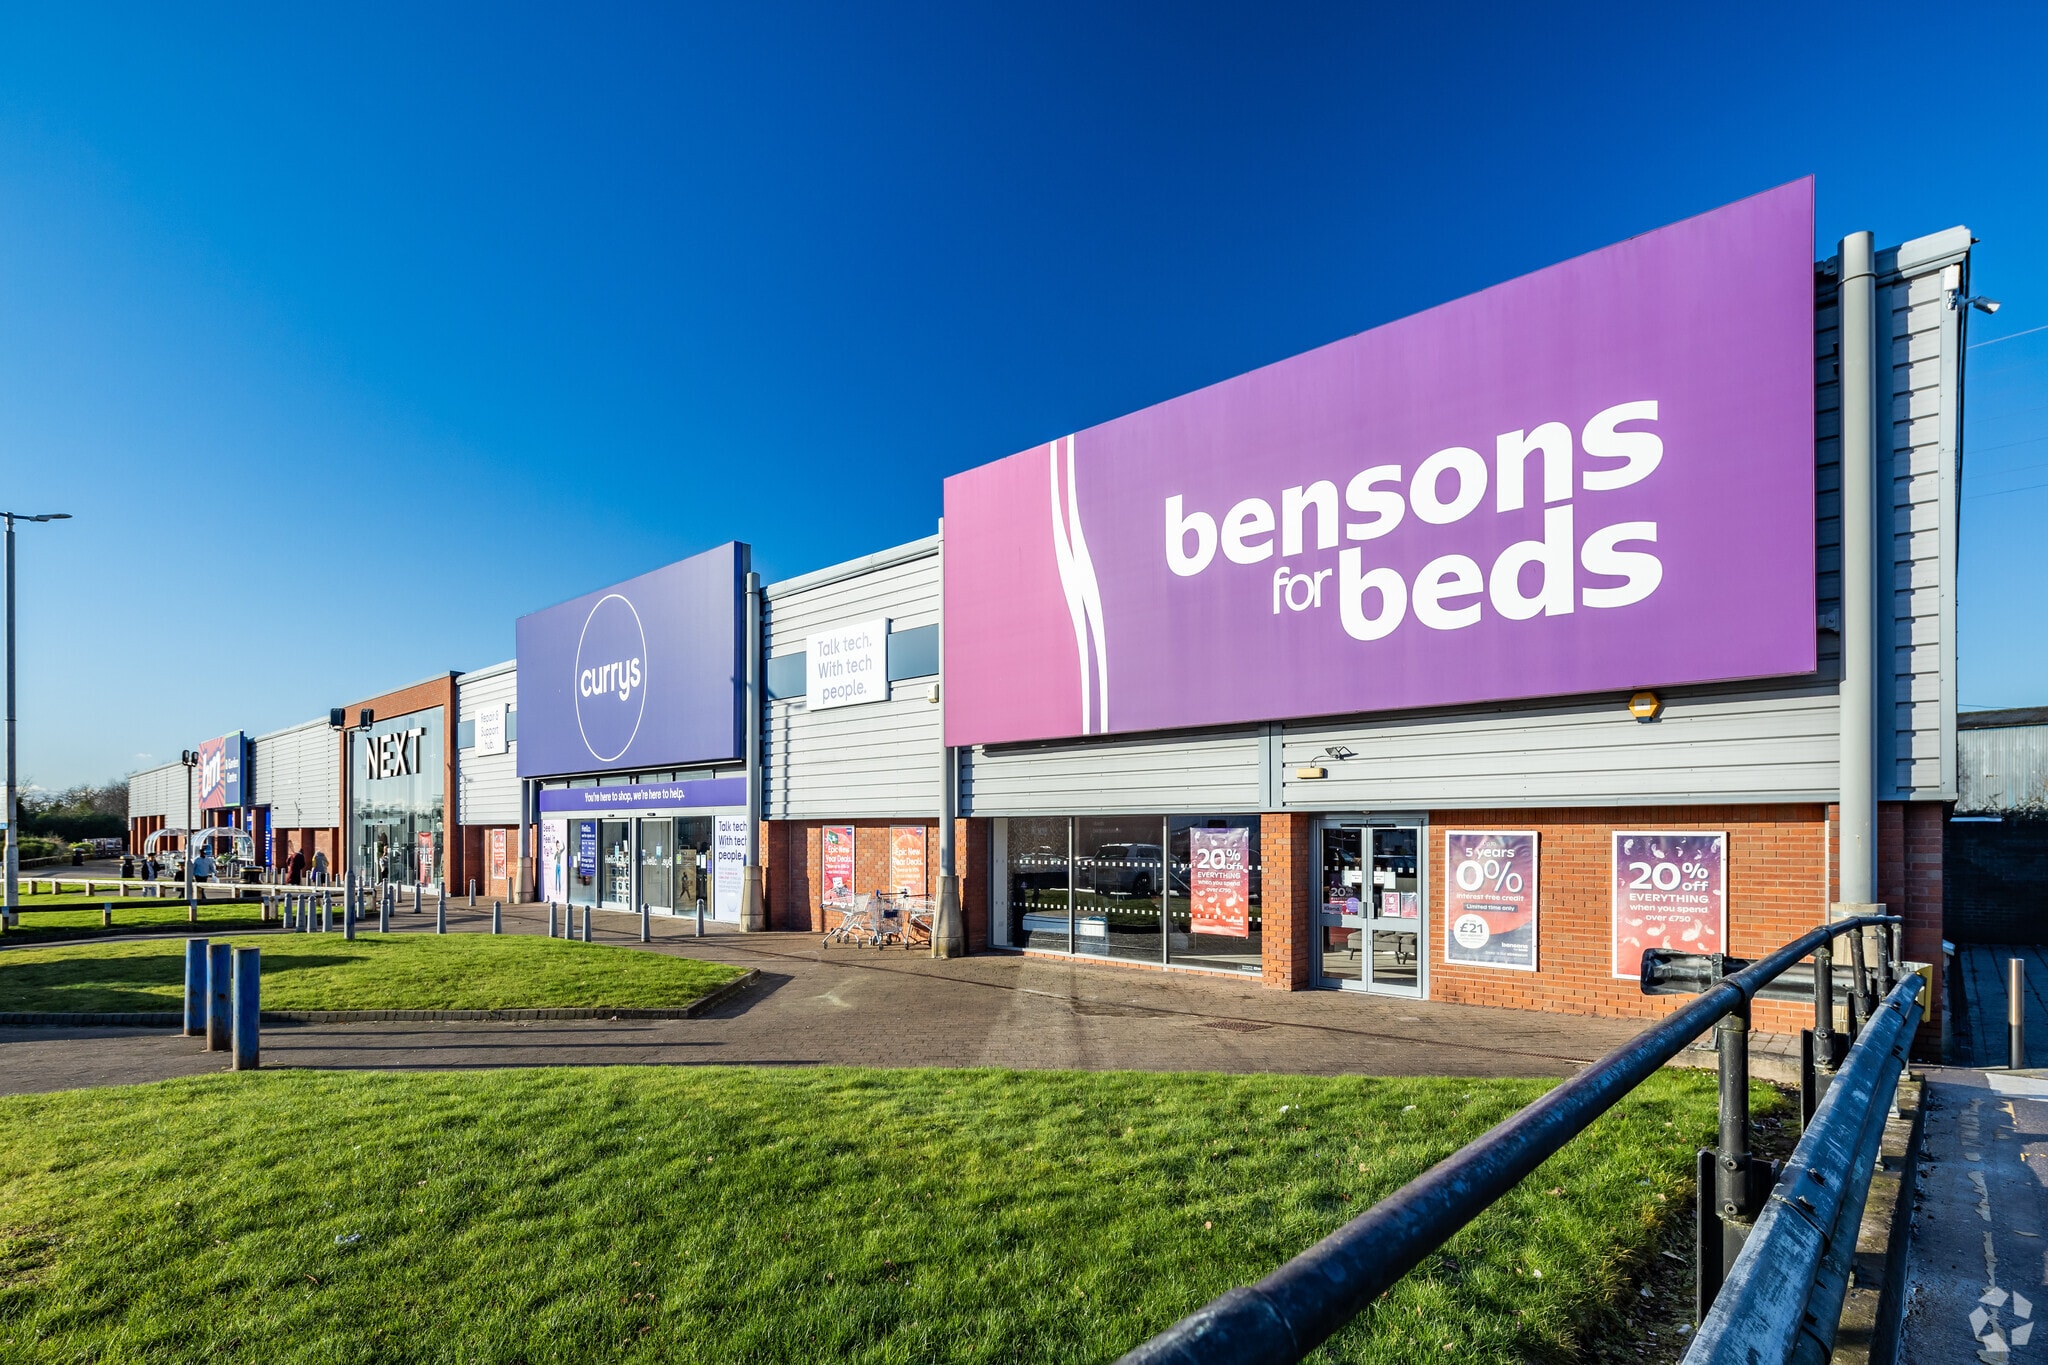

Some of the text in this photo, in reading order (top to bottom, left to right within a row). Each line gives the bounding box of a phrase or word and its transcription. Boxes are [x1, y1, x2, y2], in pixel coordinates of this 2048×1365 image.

[1165, 400, 1664, 577] bensons
[1273, 504, 1664, 641] for beds
[818, 632, 872, 658] Talk tech.
[818, 654, 872, 680] With tech
[580, 657, 642, 702] currys
[822, 680, 867, 704] people.
[481, 726, 499, 738] Support
[366, 727, 426, 780] NEXT
[584, 787, 685, 804] You're here to shop, we're here to help.
[718, 820, 747, 832] Talk tech
[718, 834, 732, 846] With
[718, 849, 743, 863] people.
[828, 845, 850, 855] Epic New
[895, 847, 920, 857] Epic New
[1465, 847, 1515, 859] 5 years
[420, 853, 432, 865] SALE
[1197, 848, 1241, 870] 20%
[1197, 871, 1241, 880] EVERYTHING
[1456, 859, 1524, 893] 0%
[1629, 861, 1709, 891] 20%
[1682, 881, 1709, 892] off
[1485, 893, 1501, 901] free
[1501, 894, 1524, 902] credit
[1629, 893, 1709, 903] EVERYTHING
[1629, 903, 1656, 911] when
[1658, 905, 1675, 913] you
[1668, 915, 1691, 923] £750
[1460, 922, 1483, 934] £21
